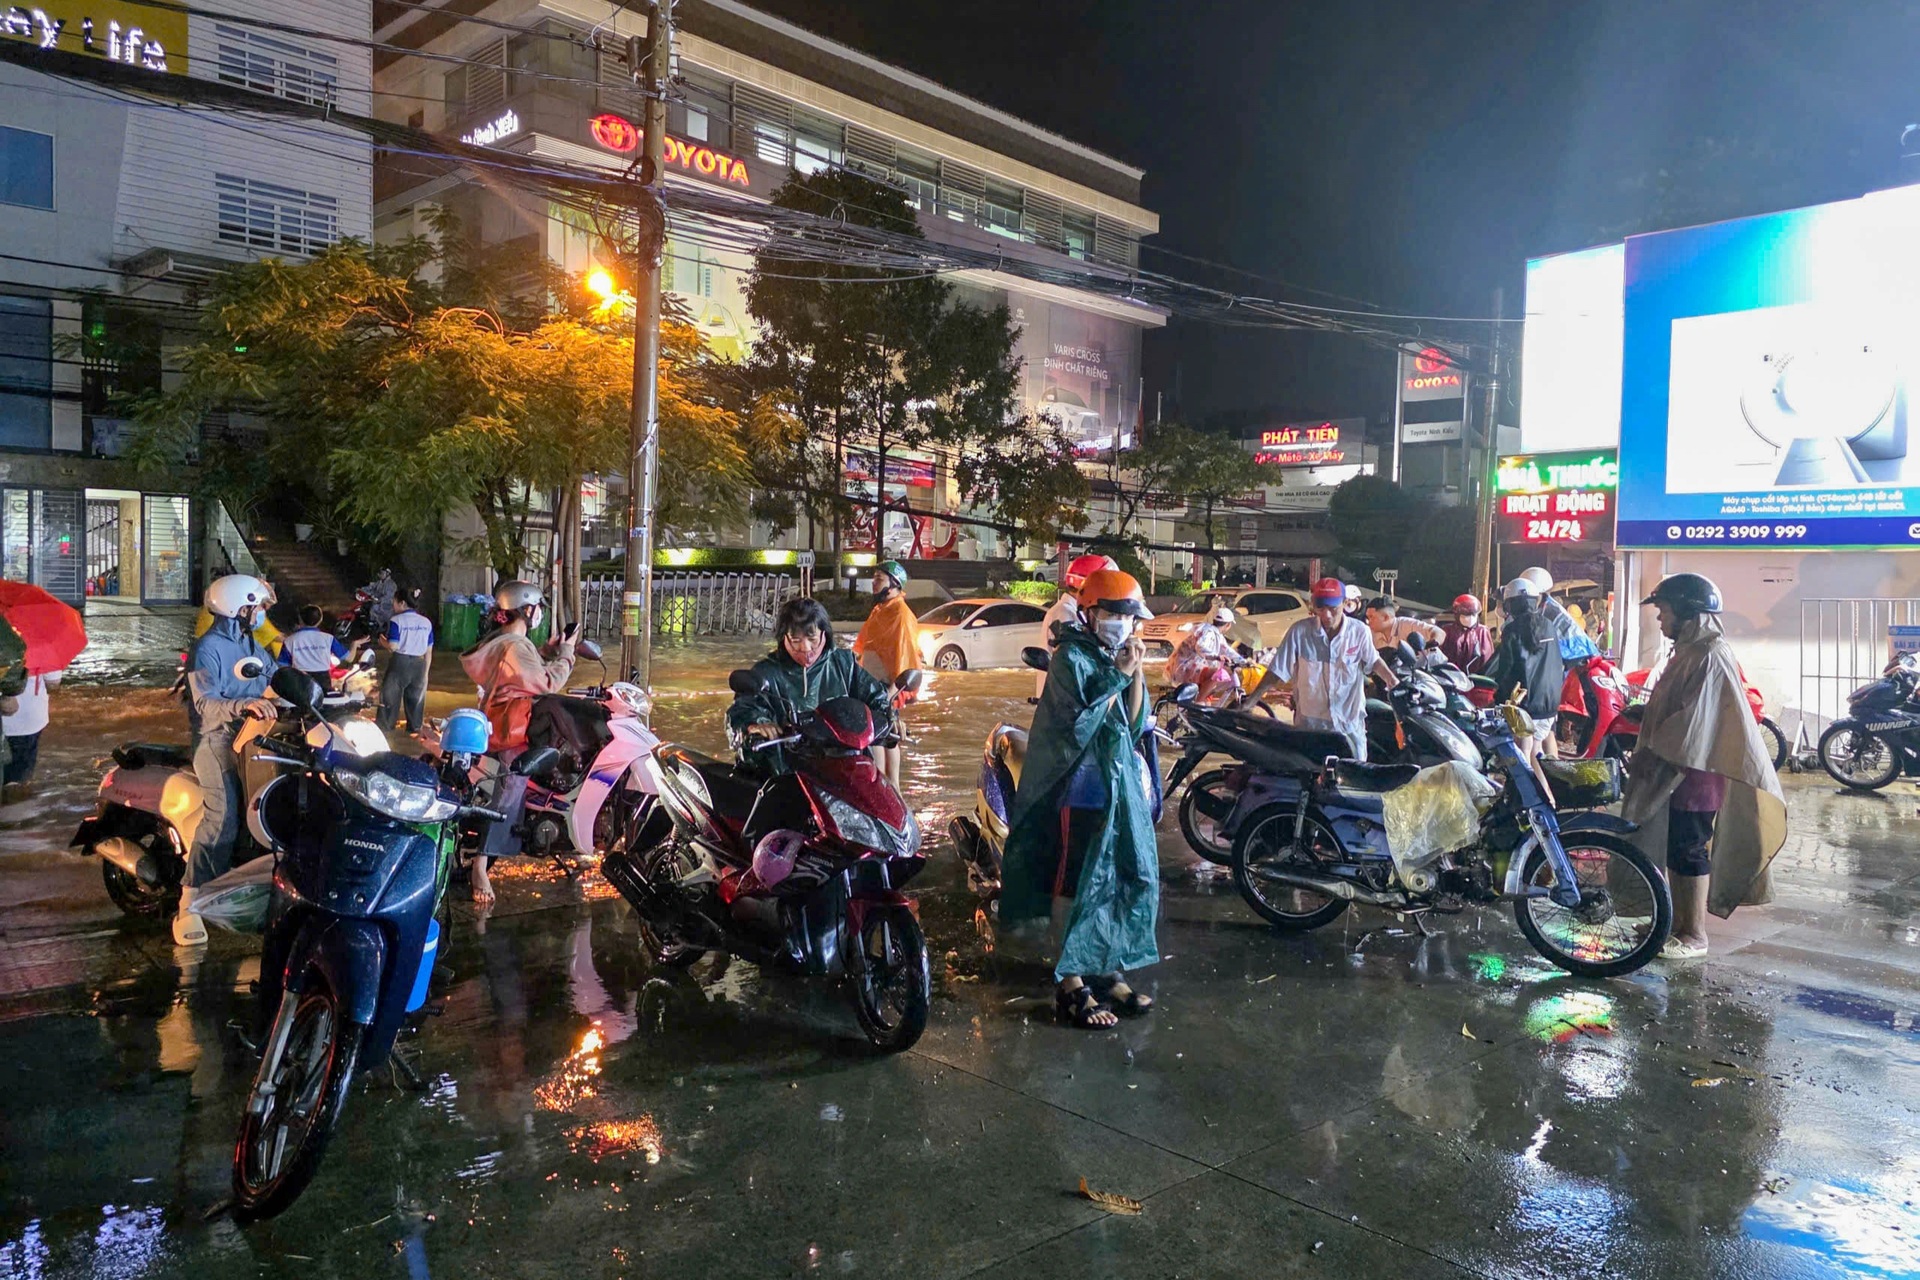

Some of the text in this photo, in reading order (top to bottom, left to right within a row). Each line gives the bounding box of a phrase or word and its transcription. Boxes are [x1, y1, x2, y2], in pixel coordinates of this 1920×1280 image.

[83, 16, 168, 73] Life
[637, 129, 750, 186] OYOTA
[1053, 343, 1075, 358] YARIS
[1075, 348, 1101, 364] CROSS
[1065, 360, 1085, 376] CHẤT
[1405, 375, 1460, 390] TOYOTA
[1262, 422, 1339, 444] PHÁT TIẾN
[1506, 489, 1606, 516] HOẠT ĐỘNG
[1751, 504, 1780, 513] Toshiba
[1527, 519, 1582, 539] 24/24
[1685, 524, 1807, 539] 0292 3909 999
[1864, 719, 1912, 732] WINNER
[343, 838, 385, 852] HONDA
[809, 855, 834, 869] HONDA
